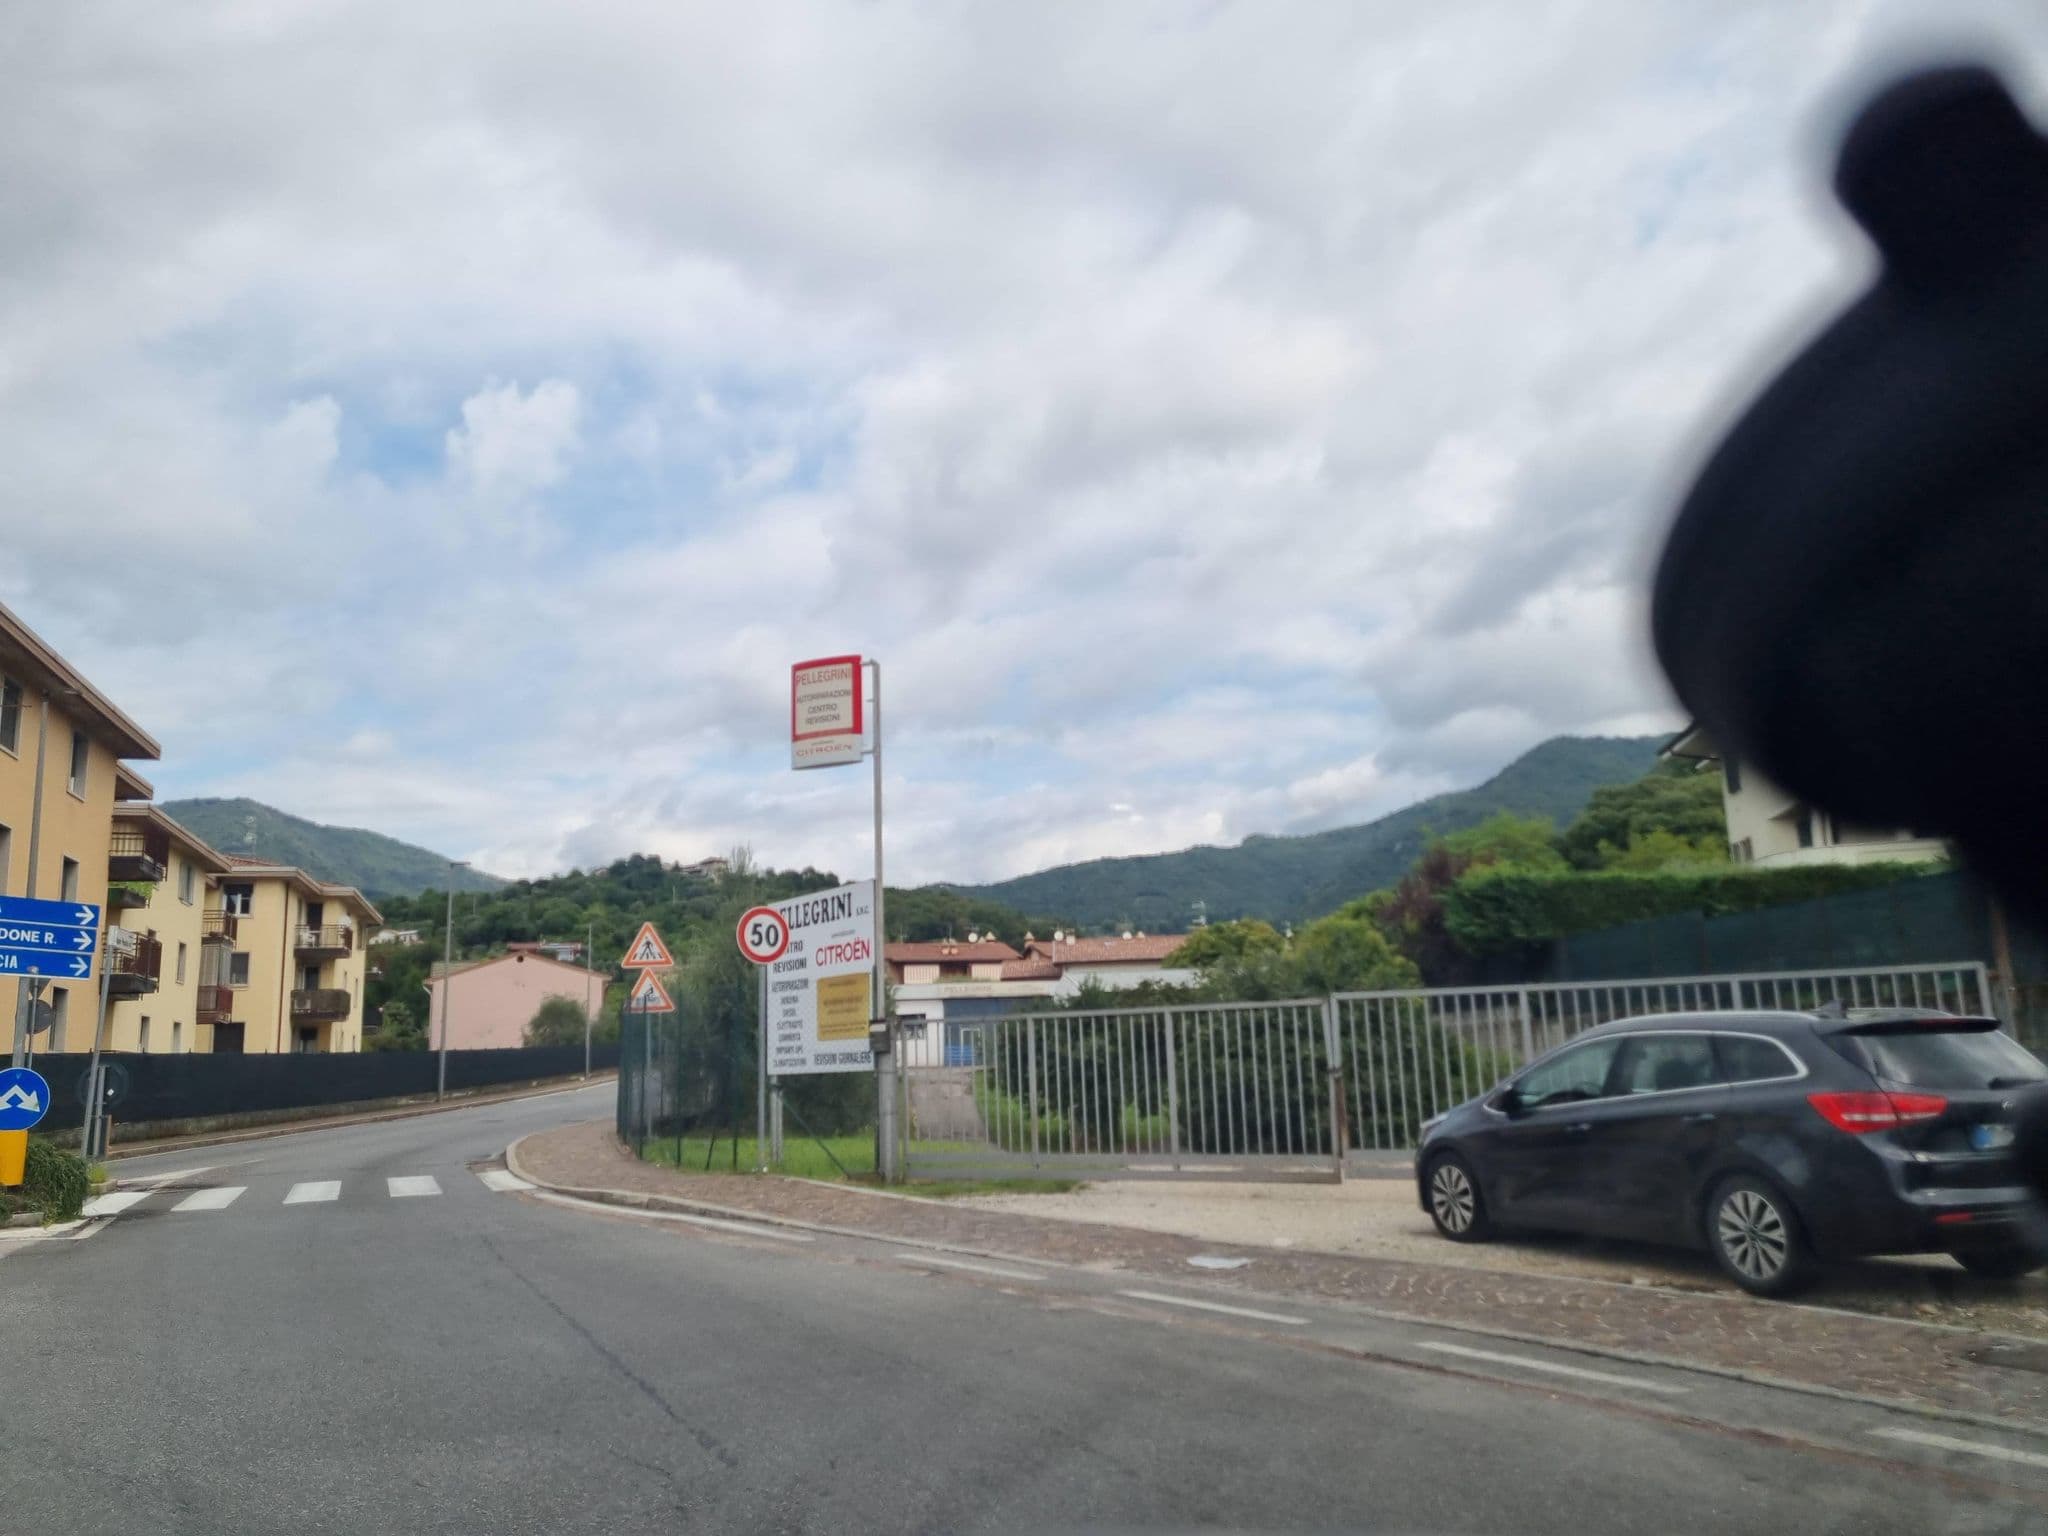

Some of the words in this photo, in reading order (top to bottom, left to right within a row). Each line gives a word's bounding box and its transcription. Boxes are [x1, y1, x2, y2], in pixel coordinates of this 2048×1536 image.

[796, 668, 851, 686] PELLEGRINI
[807, 703, 838, 714] CENTRO
[806, 714, 840, 725] REVISIONI
[44, 932, 57, 945] R.
[751, 923, 779, 947] 50
[815, 937, 870, 967] CITROËN
[773, 957, 807, 974] REVISIONI
